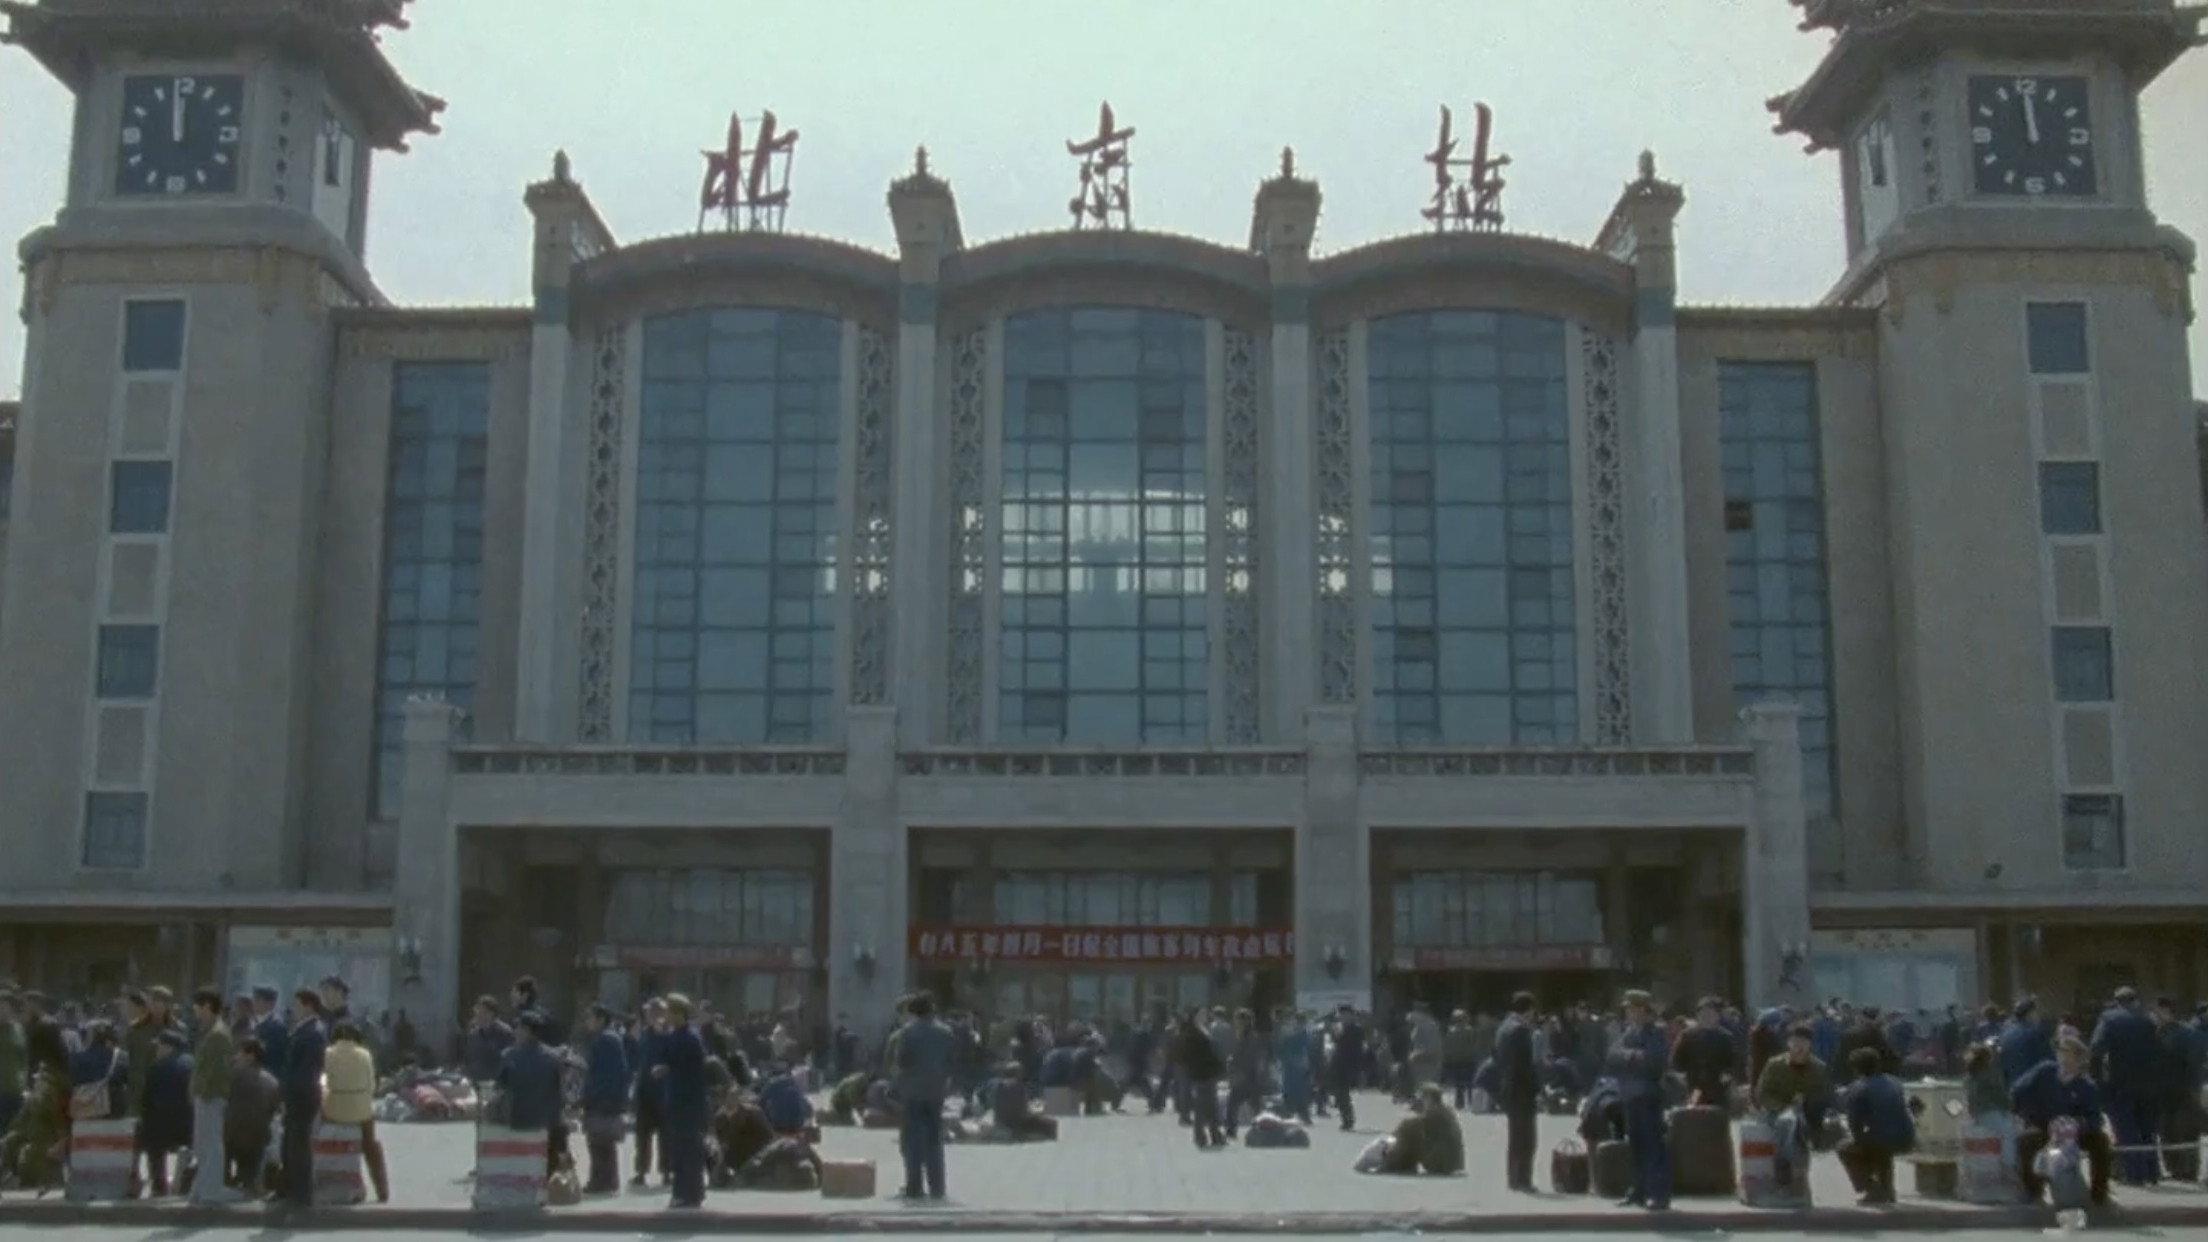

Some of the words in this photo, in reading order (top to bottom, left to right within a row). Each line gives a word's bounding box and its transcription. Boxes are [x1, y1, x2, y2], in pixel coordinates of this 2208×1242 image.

[219, 126, 239, 142] 3
[2069, 128, 2089, 145] 3
[700, 100, 1511, 222] 北京站
